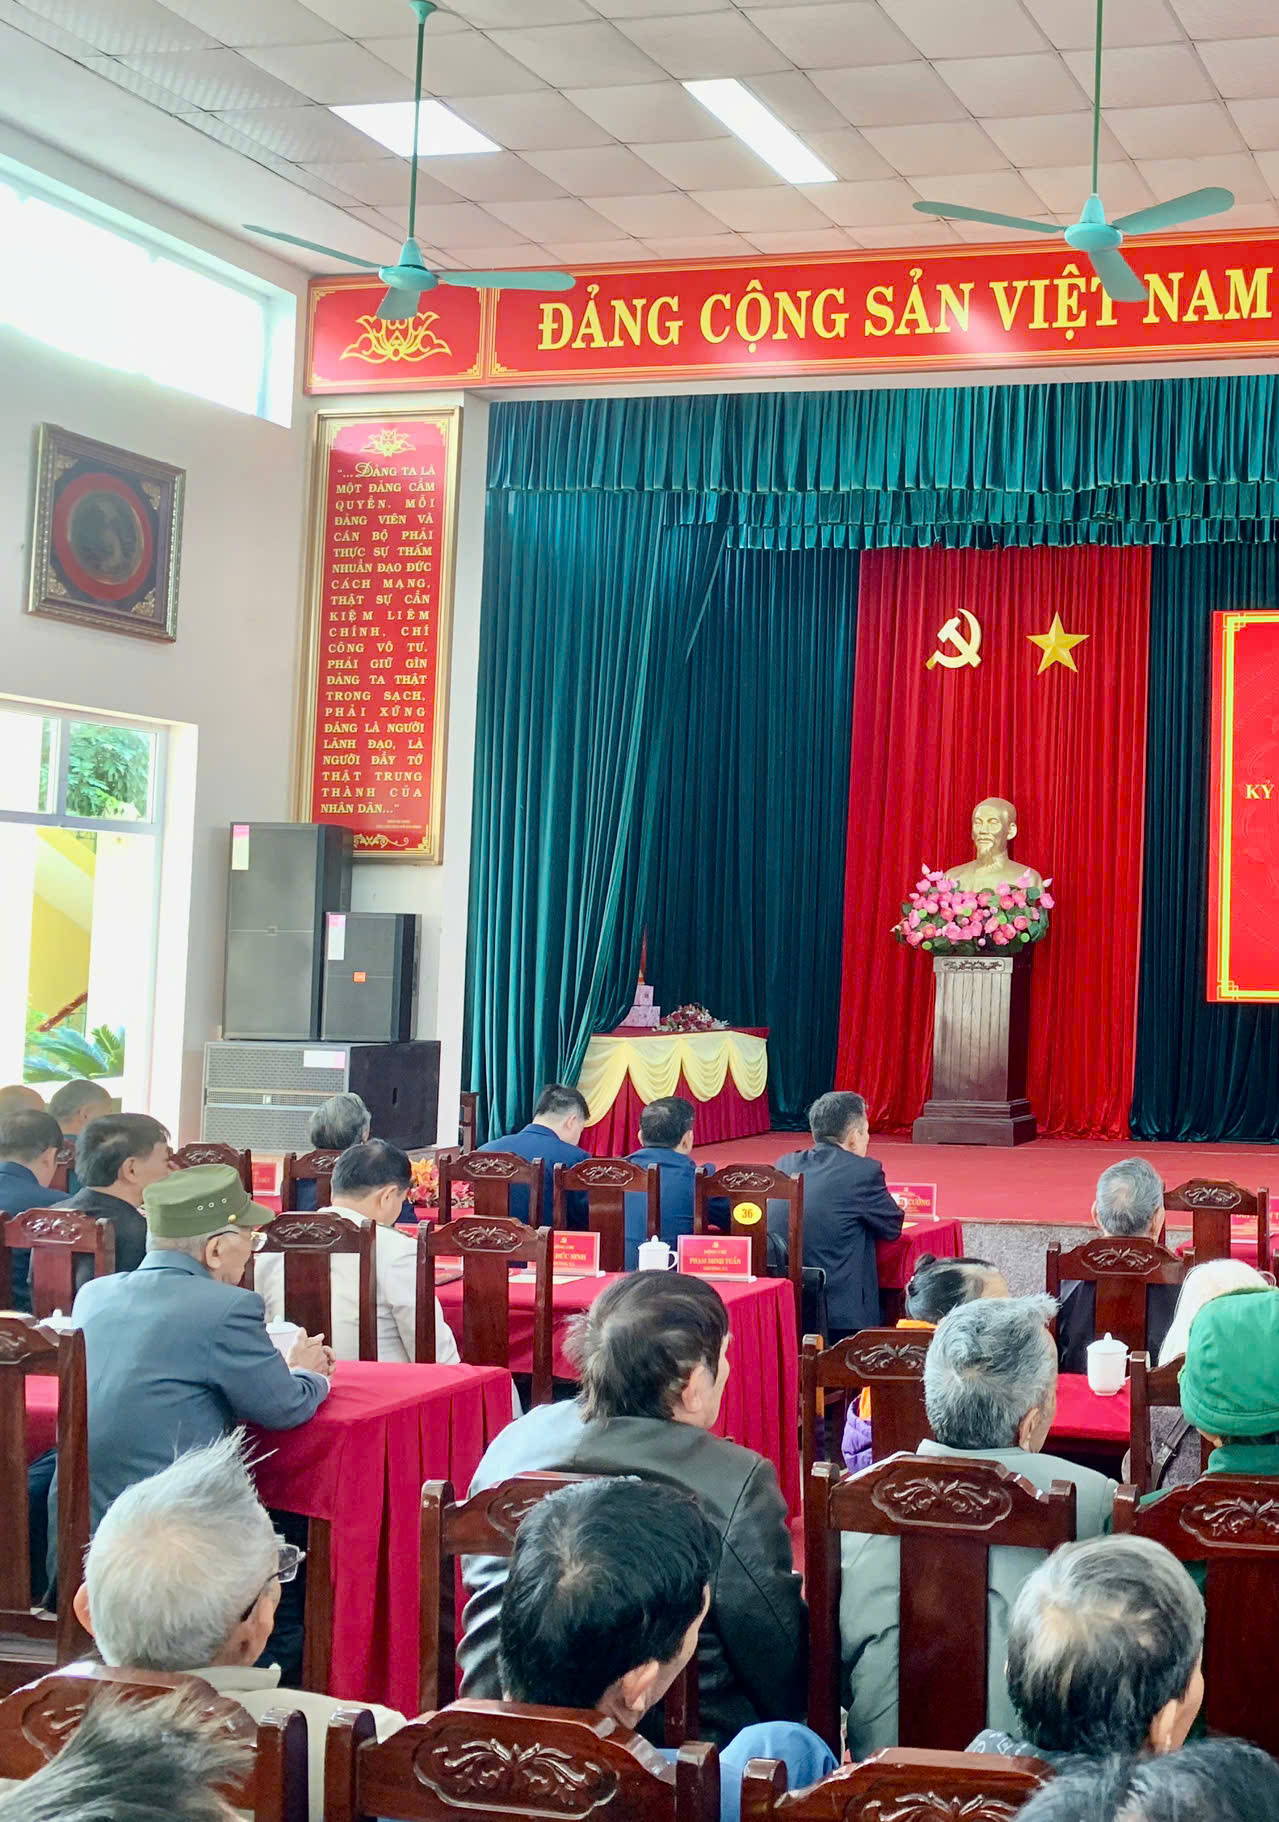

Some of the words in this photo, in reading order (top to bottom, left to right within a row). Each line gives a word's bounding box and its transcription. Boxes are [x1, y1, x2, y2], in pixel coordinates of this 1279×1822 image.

[537, 282, 684, 351] ĐẢNG
[700, 279, 849, 353] CỘNG
[863, 267, 974, 336] SẢN
[989, 263, 1120, 341] VIỆT
[1143, 265, 1272, 323] NAM
[741, 1208, 753, 1218] 36
